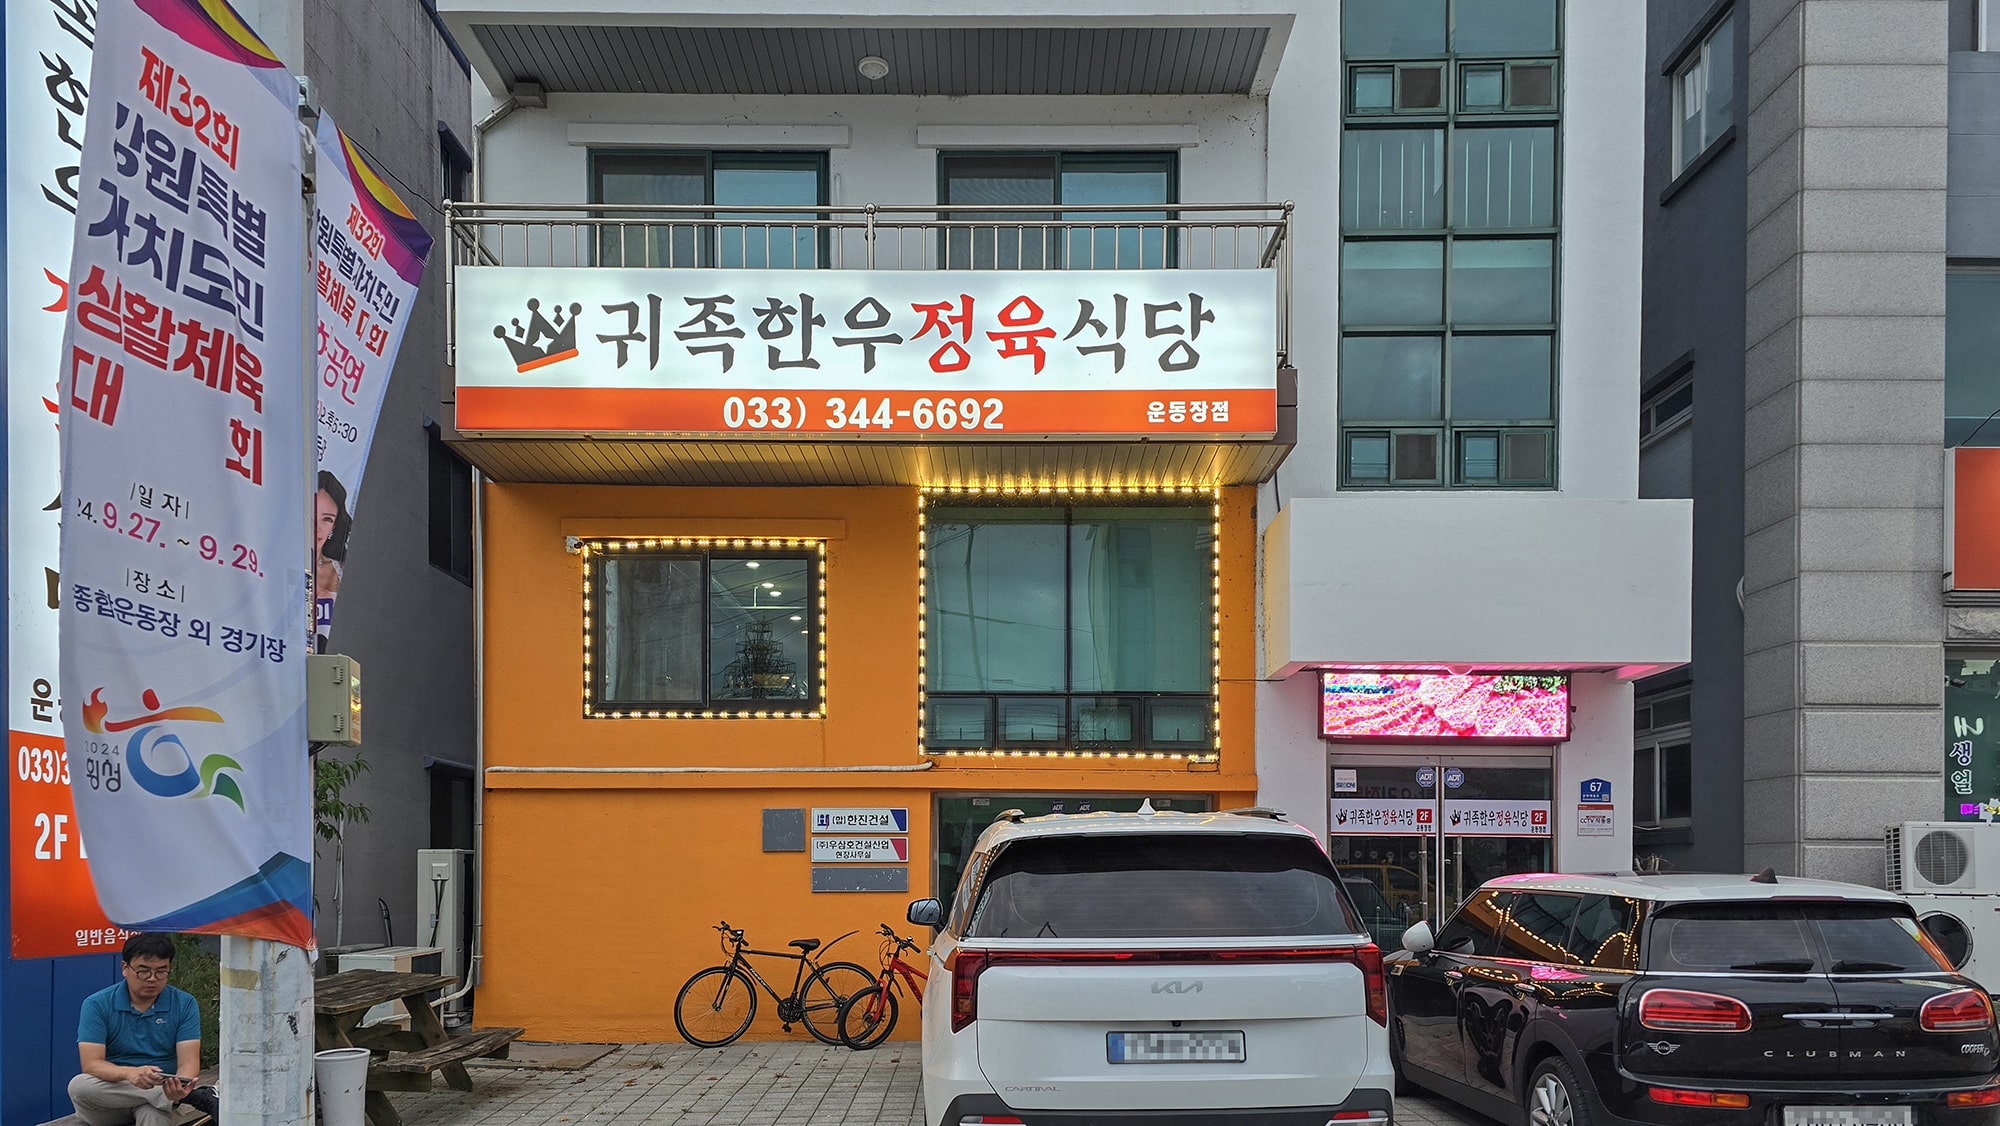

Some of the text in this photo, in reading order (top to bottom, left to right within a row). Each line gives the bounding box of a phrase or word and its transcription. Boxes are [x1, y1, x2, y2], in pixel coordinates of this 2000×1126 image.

[138, 45, 240, 172] 제32회
[113, 100, 267, 269] 강원특별
[346, 202, 385, 261] 제32회
[317, 208, 400, 325] 원특별자치도민
[317, 258, 357, 328] 활체육
[76, 264, 264, 415] 생활체육
[595, 292, 1216, 375] 귀족한우정육식당
[71, 345, 263, 486] 대 회
[723, 396, 1004, 430] 033) 344-6692
[1146, 400, 1230, 424] 운동장점
[72, 583, 287, 664] 종합운동장 외 경기장
[86, 757, 122, 793] 횡성
[1419, 773, 1434, 781] ADT
[1447, 774, 1461, 782] ADT
[1590, 782, 1602, 792] 67
[1349, 808, 1414, 826] 귀족한우정육식당
[1420, 811, 1429, 821] 2F
[1463, 809, 1529, 827] 귀족한우정육식당
[1534, 812, 1544, 822] 2F
[34, 812, 68, 861] 2F
[835, 851, 871, 859] 현장사무실
[74, 928, 142, 947] 일반음식
[1763, 1050, 1907, 1059] CLUBMAN
